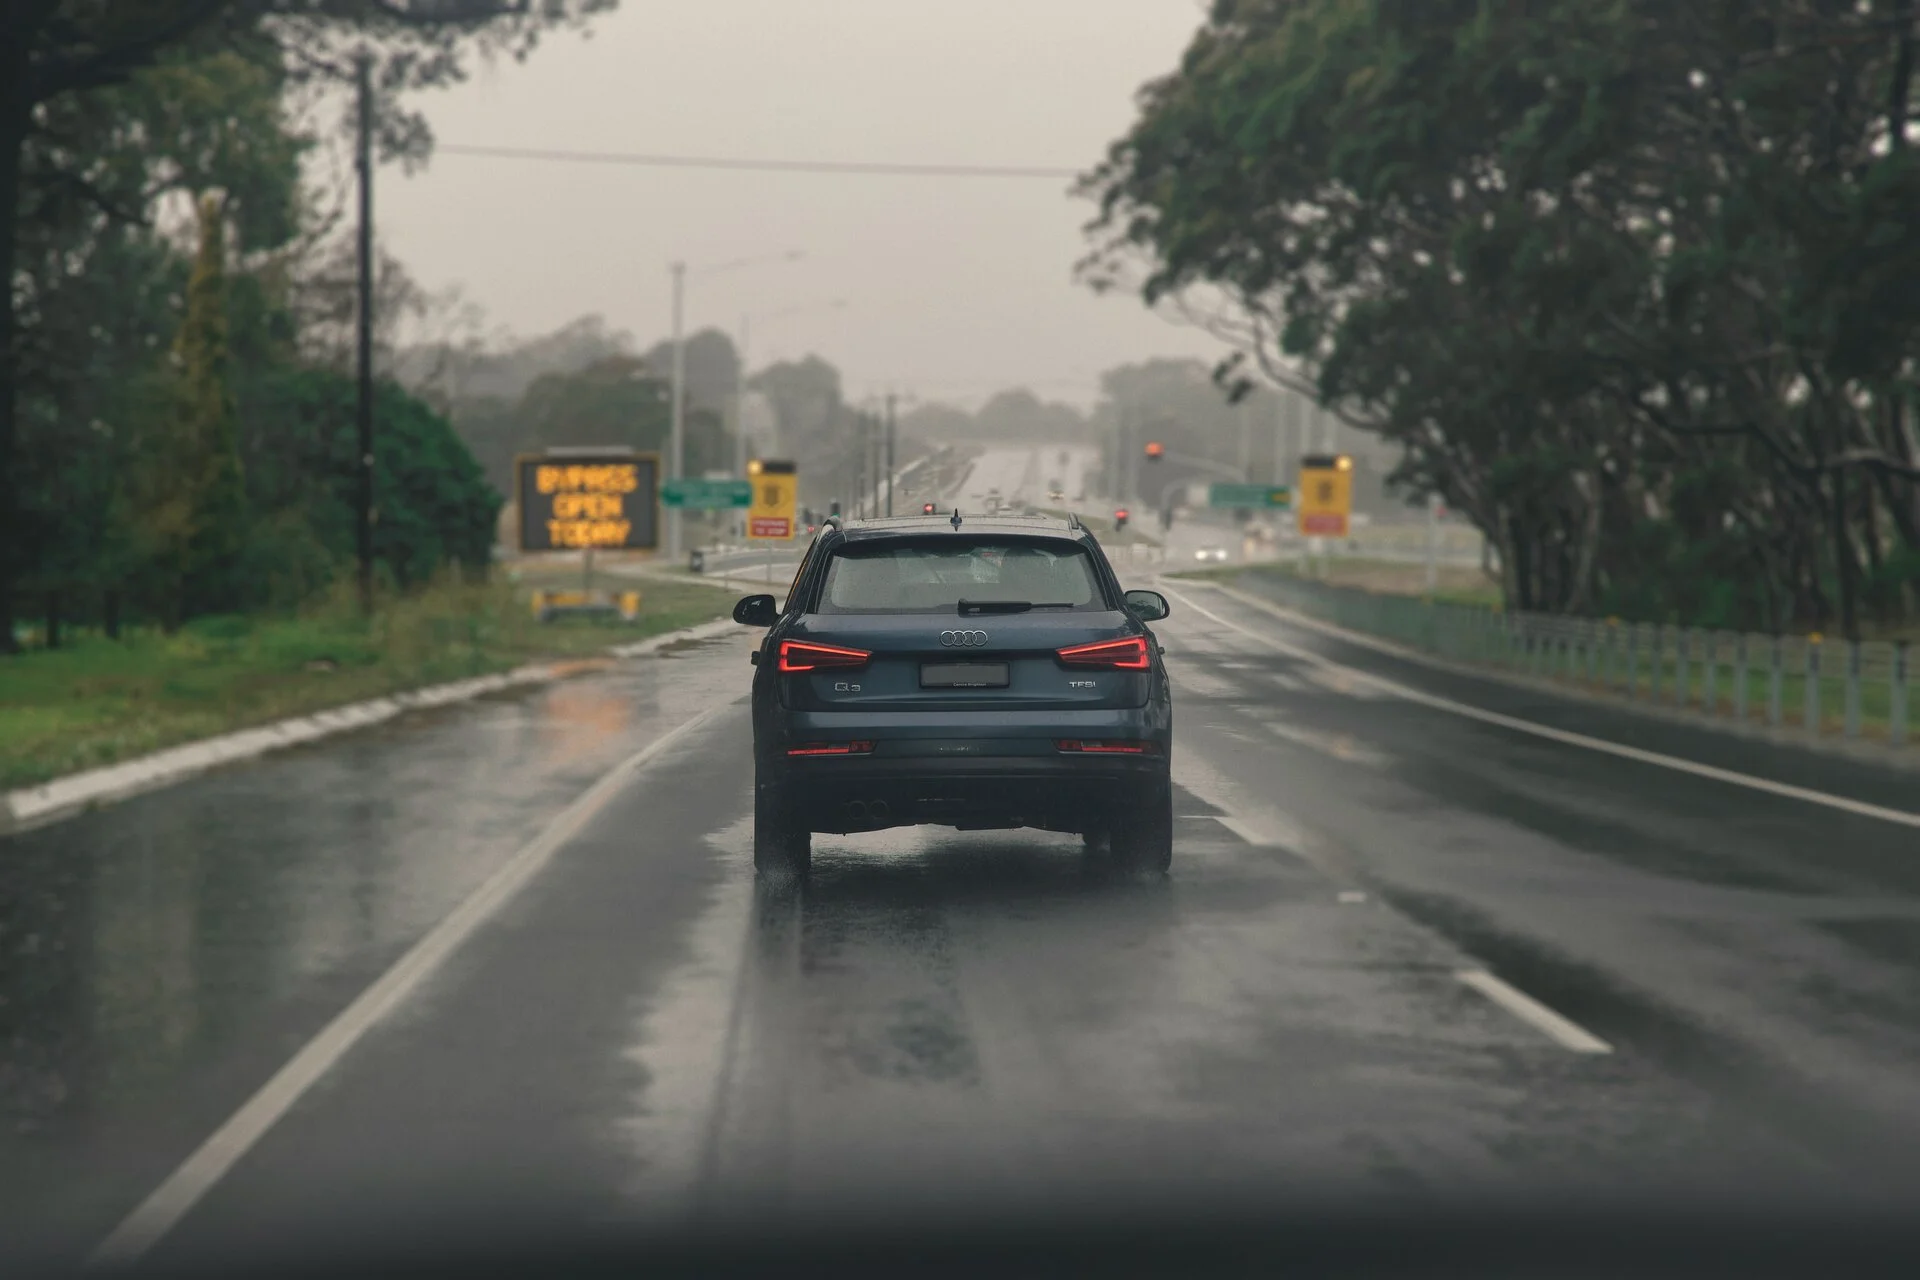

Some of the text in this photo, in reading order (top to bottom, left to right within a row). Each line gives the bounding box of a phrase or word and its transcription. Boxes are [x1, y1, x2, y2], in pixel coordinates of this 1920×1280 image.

[537, 464, 638, 493] BYPASS
[552, 493, 622, 518] OPEN
[547, 519, 631, 546] TODAY
[834, 682, 861, 692] Q3
